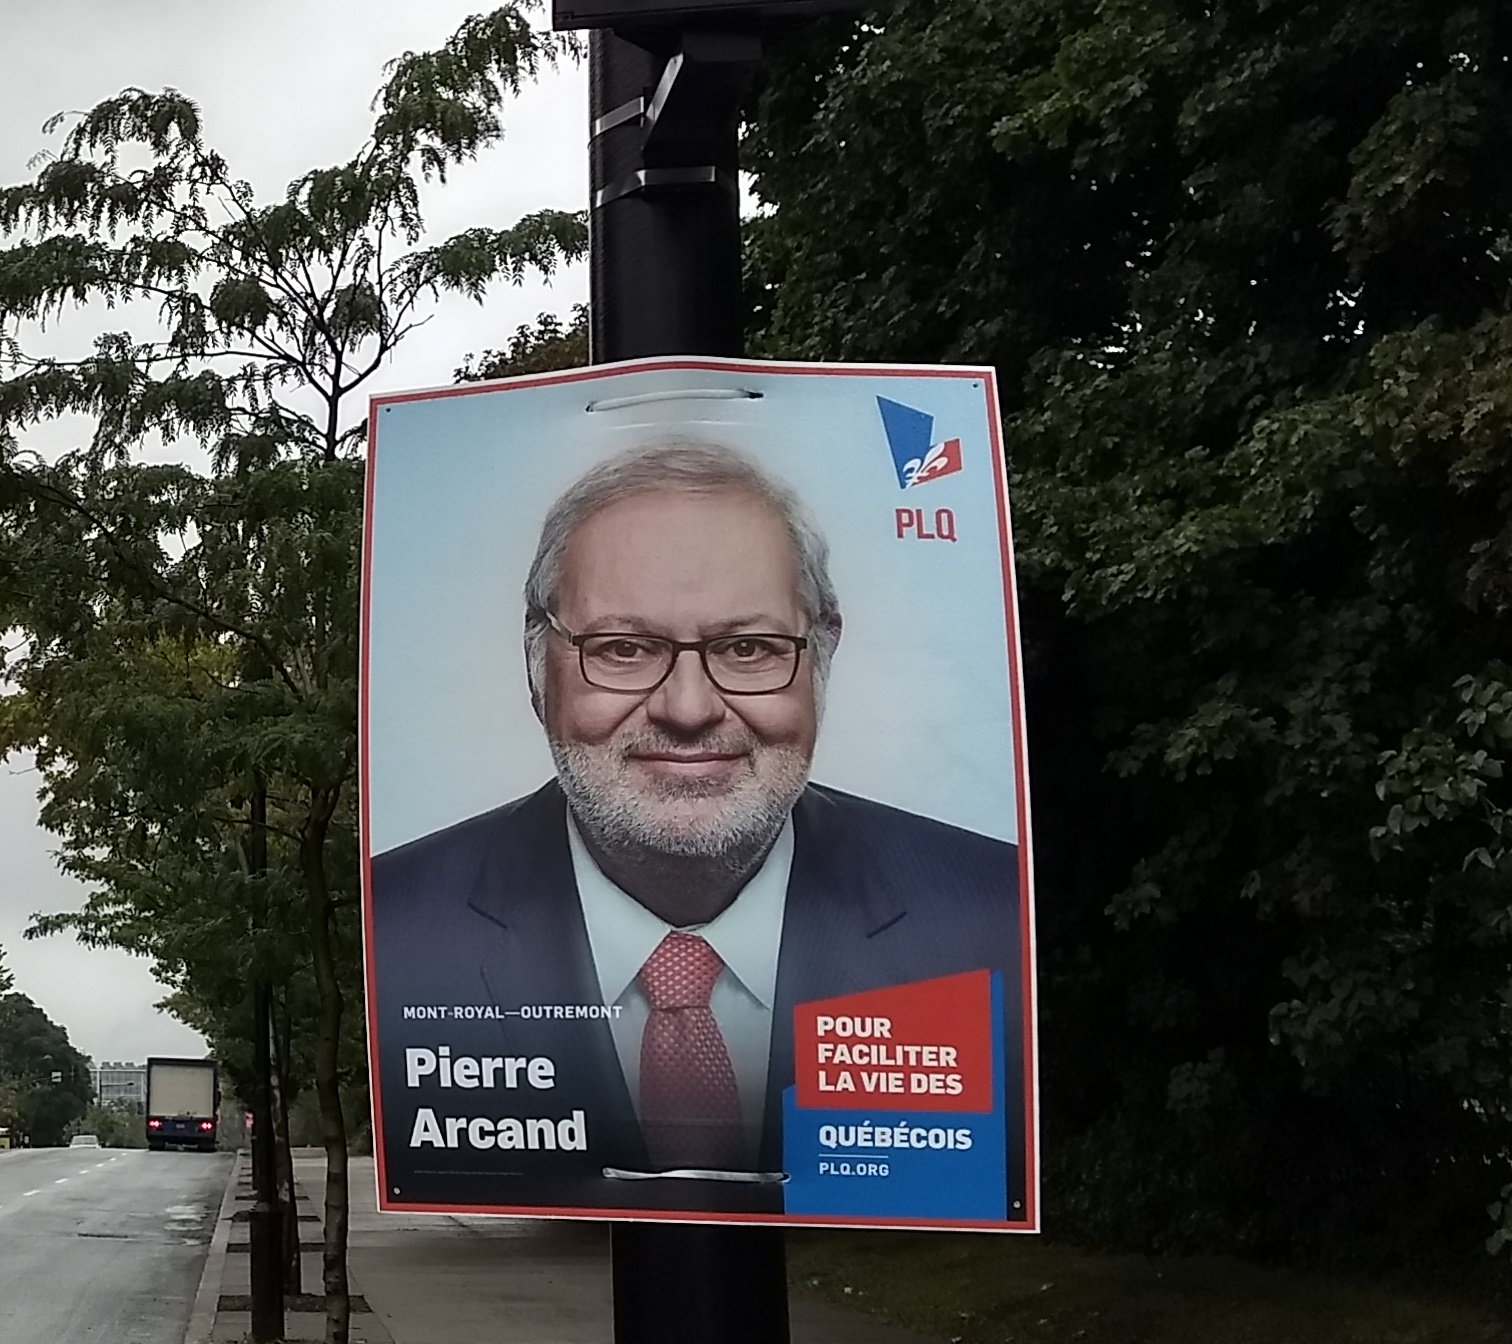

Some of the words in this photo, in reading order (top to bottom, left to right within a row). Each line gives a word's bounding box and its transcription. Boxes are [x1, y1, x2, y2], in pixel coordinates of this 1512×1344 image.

[895, 509, 957, 543] PLQ
[816, 1016, 892, 1038] POUR
[405, 1046, 555, 1089] Pierre
[817, 1043, 958, 1067] FACILITER
[818, 1071, 856, 1092] LA
[860, 1072, 905, 1093] VIE
[910, 1073, 963, 1095] DES
[409, 1108, 588, 1151] Arcand
[819, 1120, 973, 1150] QUÉBÉCOIS
[819, 1162, 889, 1176] PLQ.ORG
